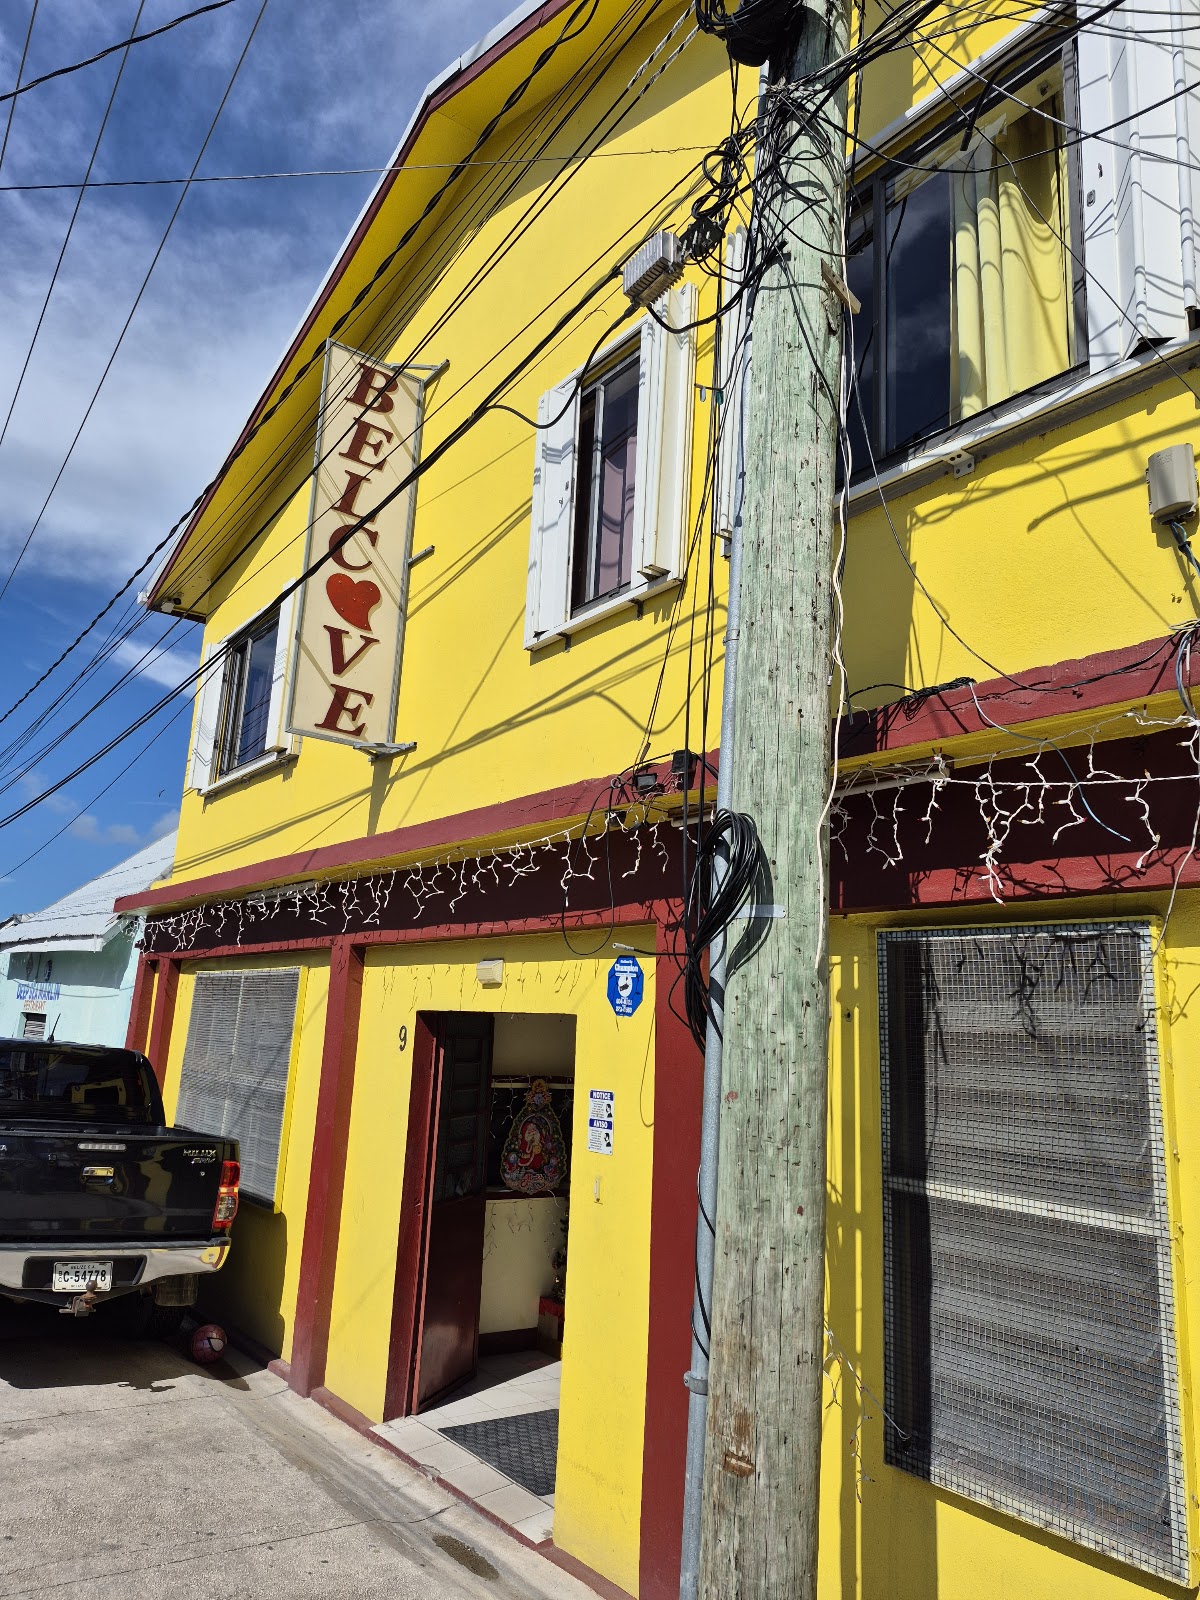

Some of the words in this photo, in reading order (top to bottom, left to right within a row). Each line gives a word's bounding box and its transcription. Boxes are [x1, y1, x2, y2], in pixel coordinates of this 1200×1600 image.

[16, 983, 29, 1000] DEEP
[399, 1025, 407, 1051] 9
[592, 1091, 611, 1099] NOTICE
[593, 1120, 608, 1128] AVISO
[183, 1149, 216, 1157] HILUX
[63, 1269, 107, 1282] C-54778
